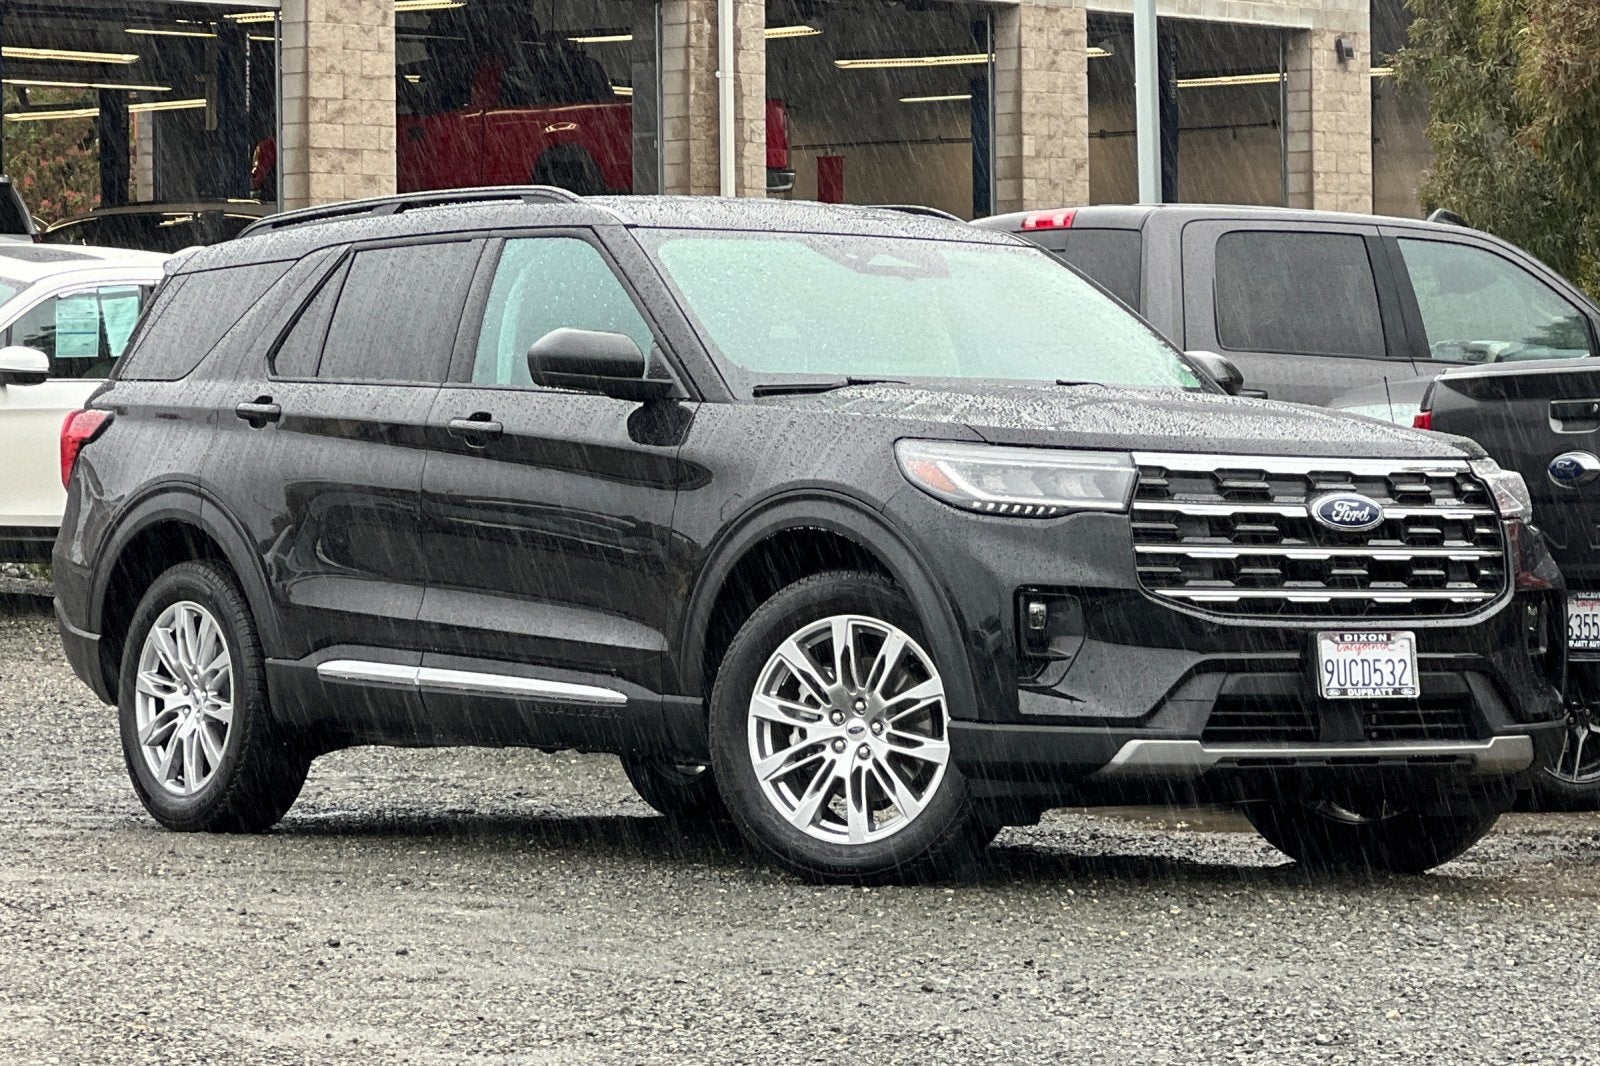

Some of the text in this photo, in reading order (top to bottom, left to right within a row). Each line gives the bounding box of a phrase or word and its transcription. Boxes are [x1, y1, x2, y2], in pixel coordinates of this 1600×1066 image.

[1331, 501, 1370, 522] Ford
[1344, 633, 1387, 642] DIXON
[1325, 658, 1408, 687] 9UCD532
[1347, 688, 1394, 696] DUPRATT
